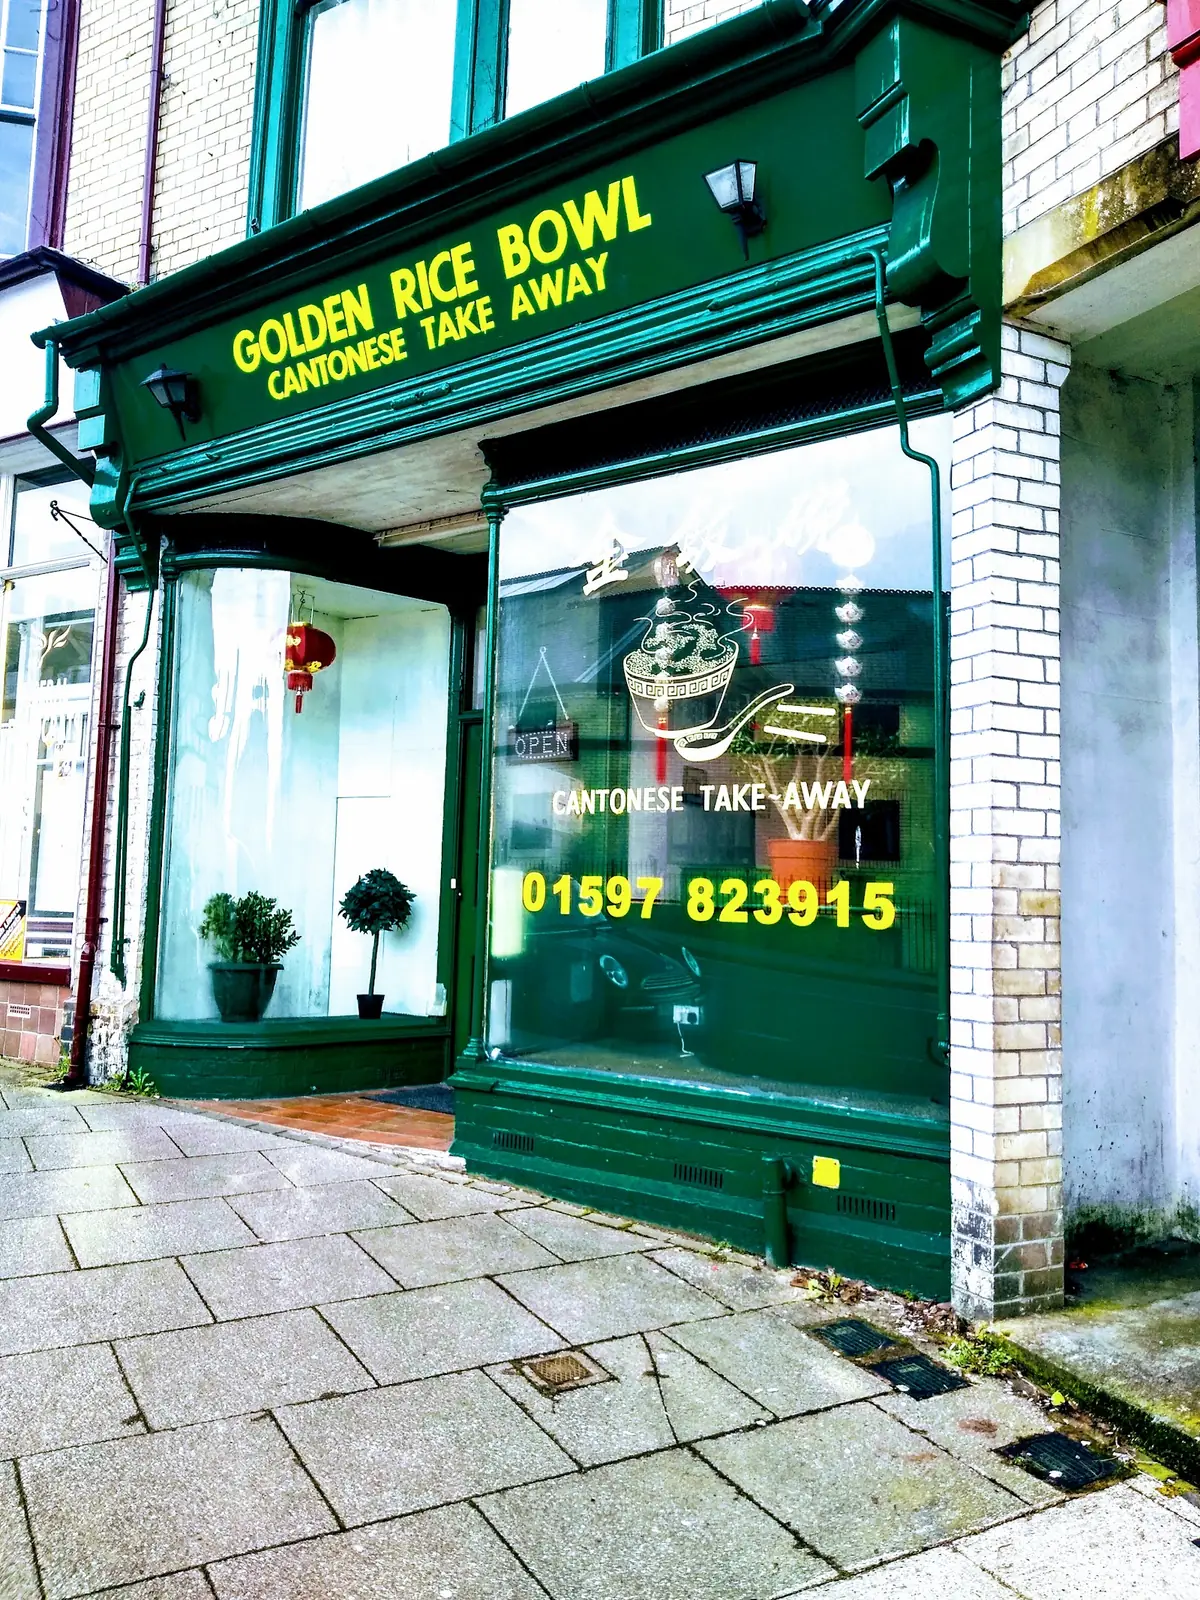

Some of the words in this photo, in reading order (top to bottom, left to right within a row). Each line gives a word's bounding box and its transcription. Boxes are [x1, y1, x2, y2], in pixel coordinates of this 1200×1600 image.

[232, 283, 375, 373] GOLDEN
[389, 241, 479, 320] RICE
[497, 175, 652, 280] BOWL
[267, 327, 408, 400] CANTONESE
[419, 295, 495, 350] TAKE
[511, 252, 609, 321] AWAY
[515, 735, 567, 755] OPEN
[553, 786, 684, 815] CANTONESE
[521, 871, 662, 919] 01597
[687, 877, 897, 930] 823915
